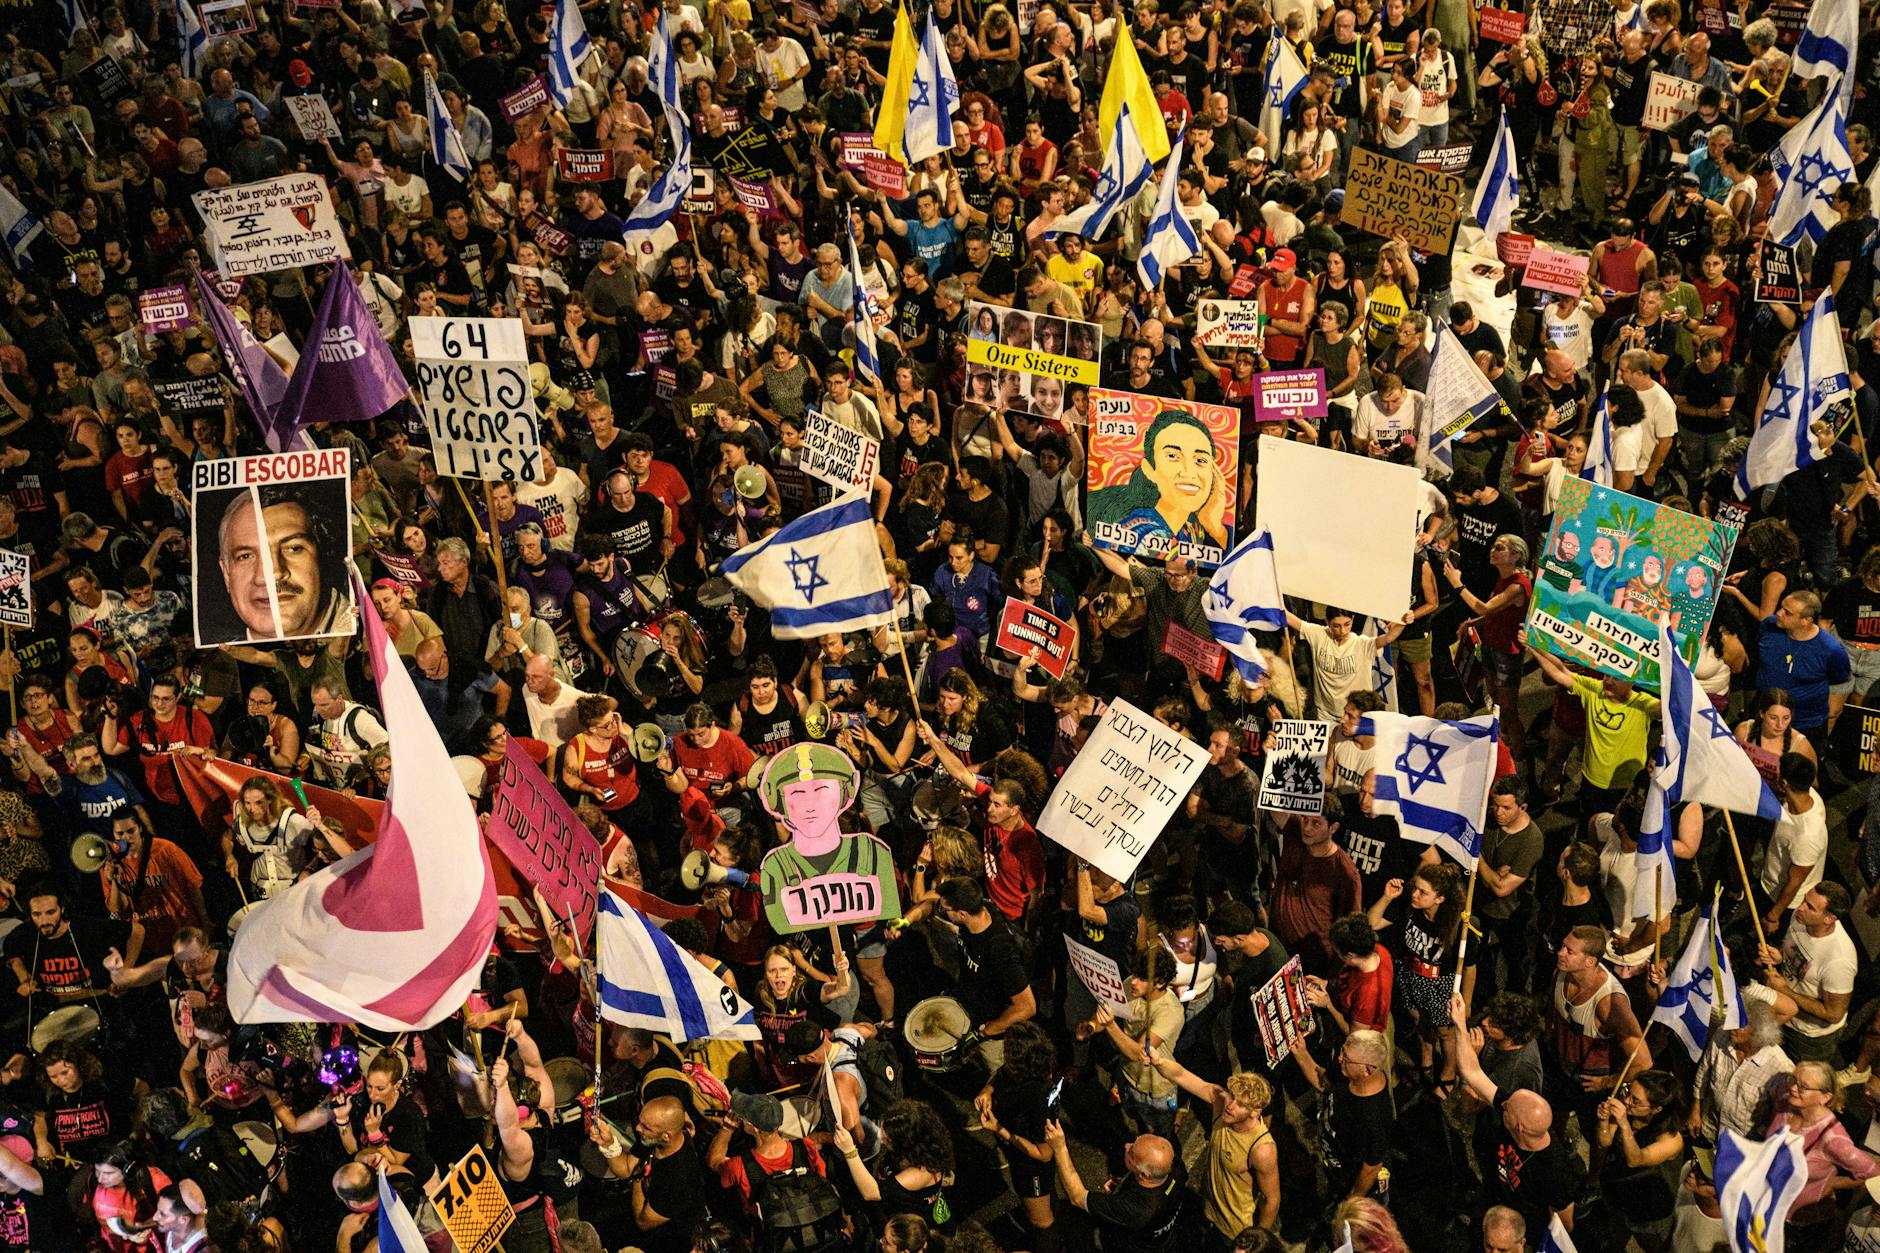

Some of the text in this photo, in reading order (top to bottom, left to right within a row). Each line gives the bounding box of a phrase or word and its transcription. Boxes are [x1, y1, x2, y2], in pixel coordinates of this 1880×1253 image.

[1481, 23, 1503, 34] DEAL
[1482, 14, 1522, 30] HOSTAGE
[511, 91, 544, 115] עכשיו
[1418, 145, 1473, 163] הפסקת אש
[1441, 155, 1470, 167] עכשיו
[572, 163, 601, 174] הזמן!
[1358, 154, 1460, 195] תאהבו את
[236, 190, 251, 202] של
[1348, 168, 1457, 211] האזרחים שלכם
[265, 198, 278, 208] של
[1356, 188, 1452, 225] כמו שאתם
[1357, 204, 1447, 239] אוהבים את
[1530, 260, 1562, 274] דורשות
[1767, 259, 1791, 275] תתנו
[1774, 247, 1788, 264] אל
[1761, 285, 1796, 299] להקריב
[144, 305, 185, 320] עכשיו
[443, 322, 488, 359] 64
[986, 345, 1079, 378] Our Sisters
[418, 362, 526, 410] פושעים
[1260, 375, 1286, 383] העסקה
[1300, 372, 1318, 381] לקבל
[180, 394, 204, 402] STOP
[182, 397, 225, 410] THE WAR
[1099, 401, 1131, 413] נועה
[1266, 391, 1314, 404] עכשיו
[808, 413, 832, 437] עכשיו
[1099, 421, 1136, 435] בבית!
[195, 450, 347, 489] BIBI ESCOBAR
[447, 443, 539, 482] עלינו
[1719, 502, 1748, 522] FCK
[1096, 523, 1221, 563] רוצים את כולם!
[8, 554, 27, 568] מי
[1028, 613, 1058, 637] TIME IS
[1589, 616, 1639, 645] יחזרו.
[1007, 622, 1065, 660] RUNNING OUT!
[1535, 612, 1634, 670] עסקה עכשיו!
[1273, 721, 1327, 737] מי שהרס
[1107, 708, 1195, 775] הלחץ הצבאי
[1301, 738, 1325, 752] לא
[1100, 748, 1178, 807] הורג חטופים
[503, 756, 573, 854] מפקירים
[1294, 796, 1320, 812] בחירות
[497, 793, 541, 857] בשטח
[1060, 790, 1146, 858] עסקה עכשיו
[579, 846, 600, 887] לא
[541, 840, 596, 921] חיילים
[788, 881, 875, 920] הופקר
[44, 957, 79, 972] כולנו
[1071, 955, 1122, 990] עסקה
[1266, 999, 1284, 1046] SORRY FOR
[1275, 976, 1296, 1045] BEING KIDNAPPED
[433, 1153, 487, 1220] 7.10
[491, 1204, 512, 1239] בחירות
